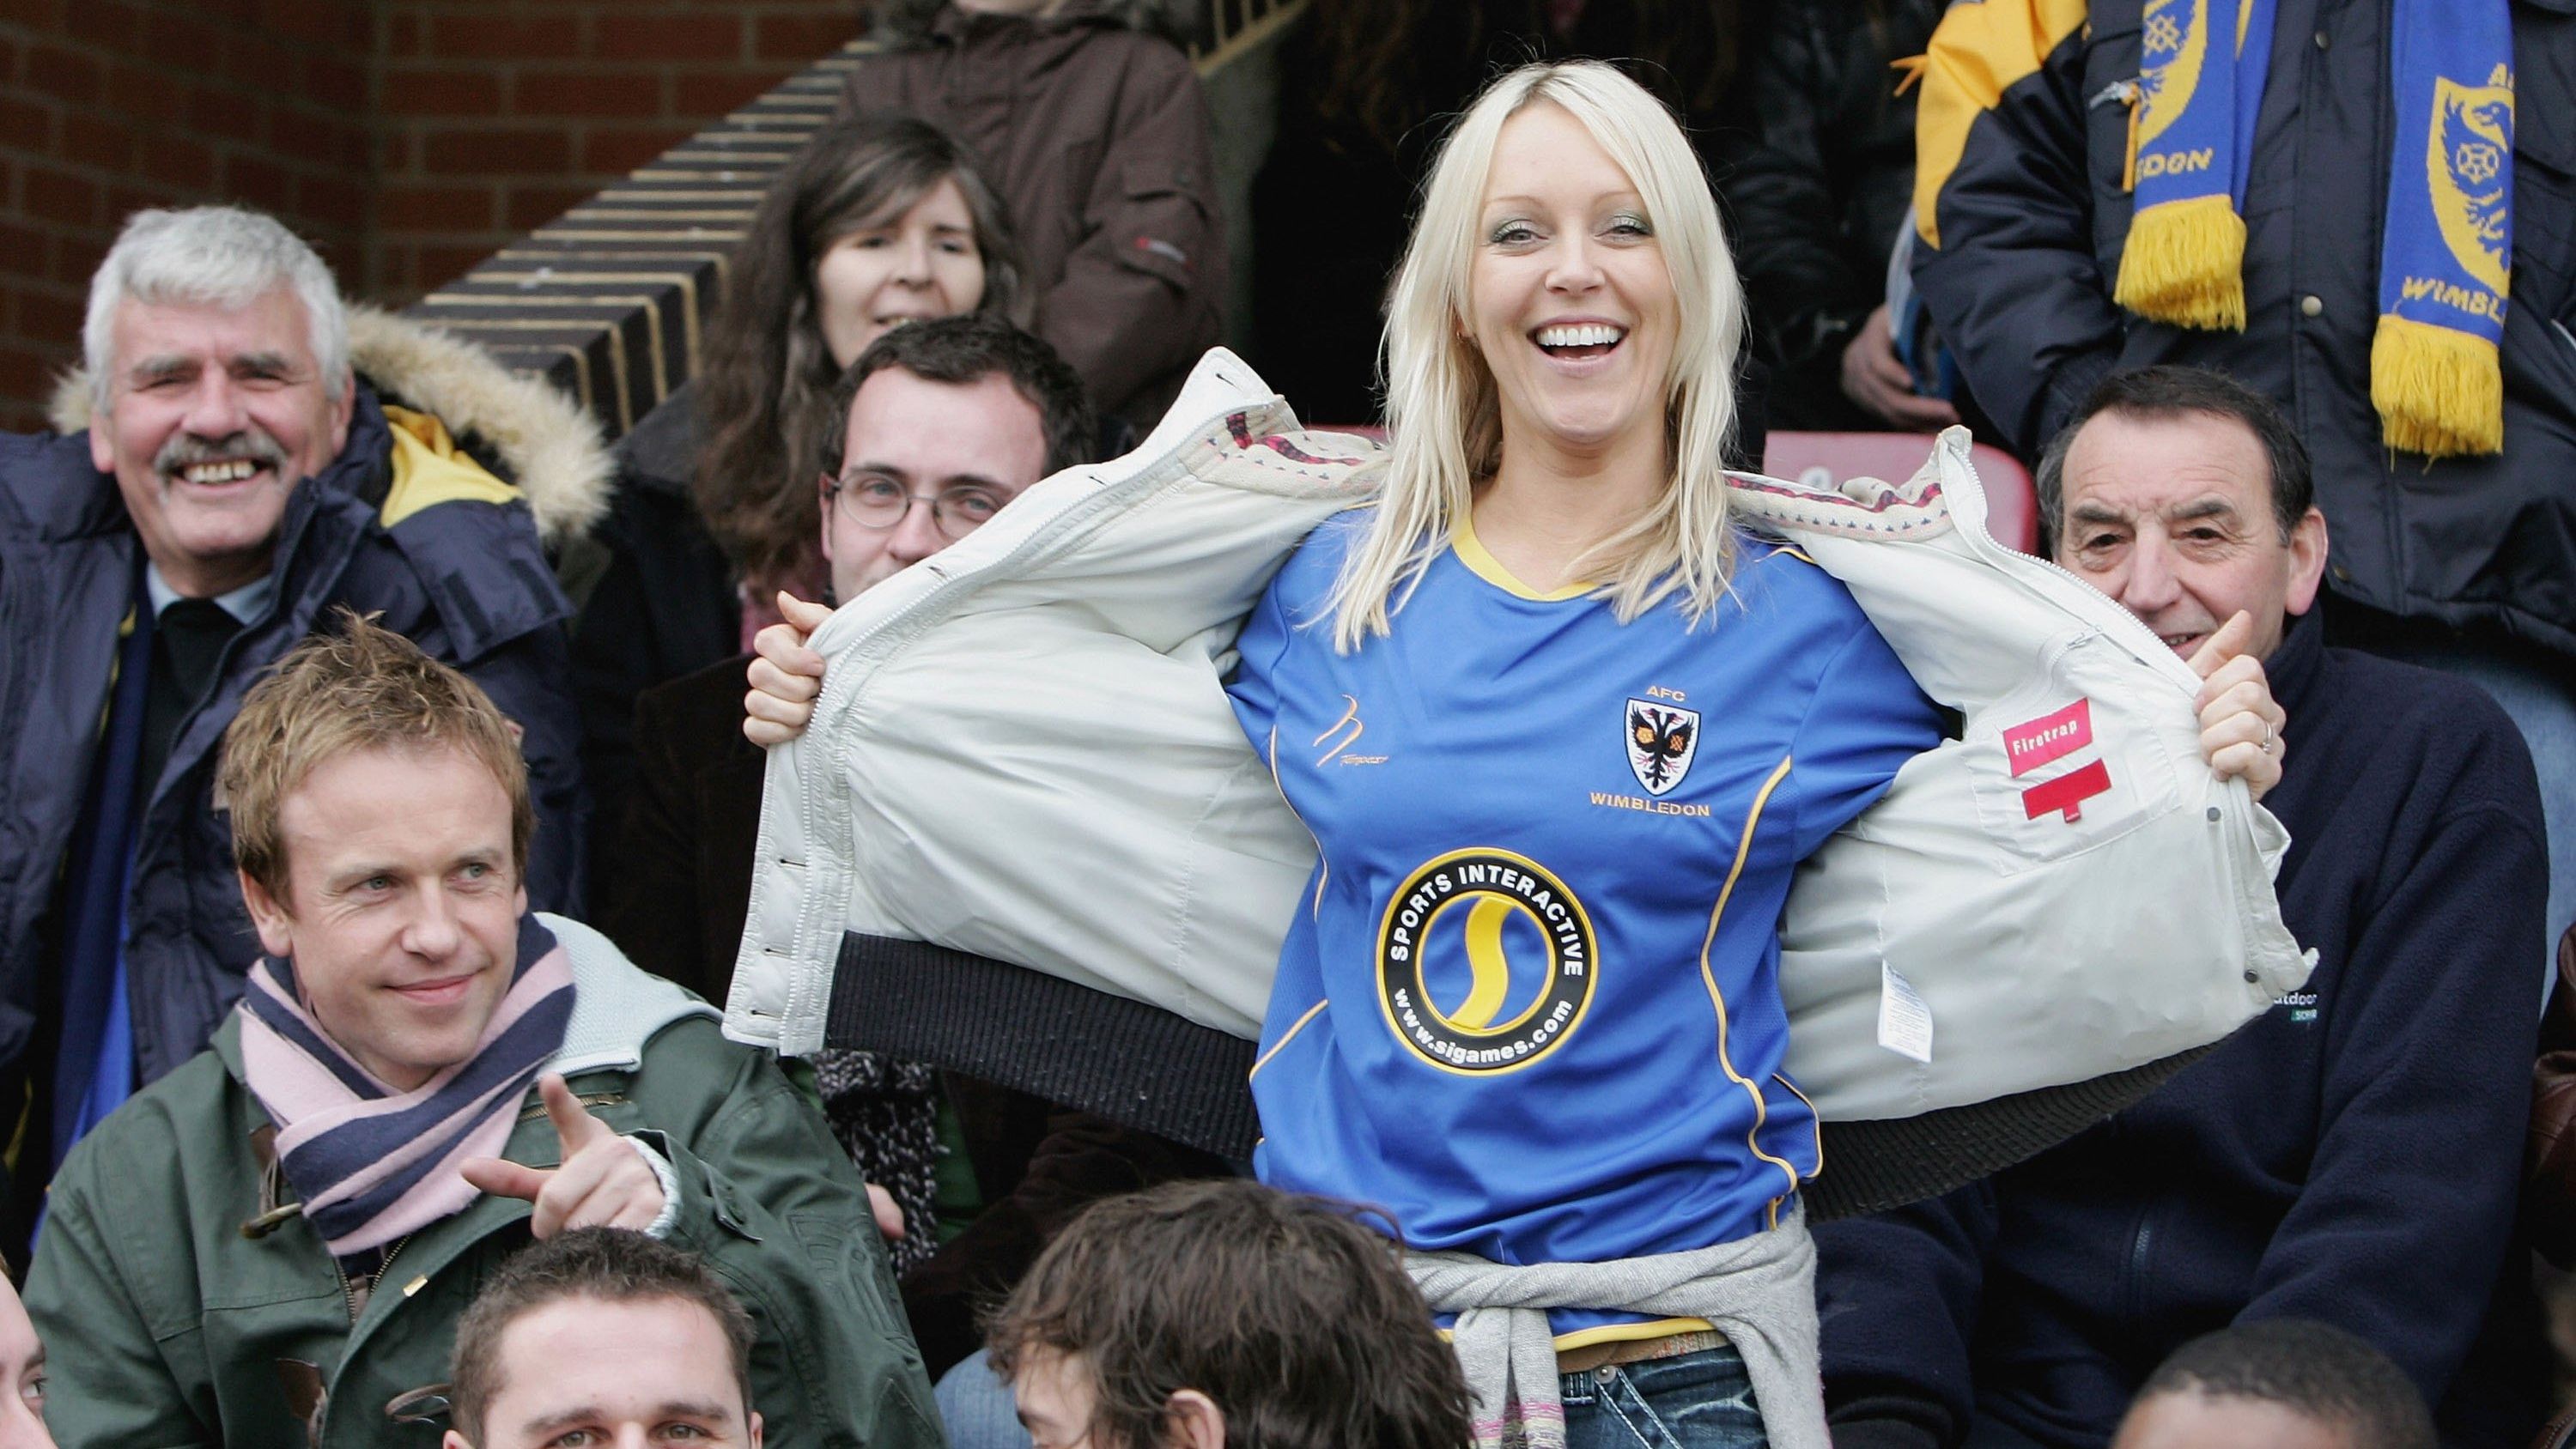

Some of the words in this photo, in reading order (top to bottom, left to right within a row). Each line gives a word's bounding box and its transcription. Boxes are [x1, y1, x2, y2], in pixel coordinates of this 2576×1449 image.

[1646, 685, 1686, 702] AFC
[2012, 719, 2078, 756] Firetrap
[1589, 791, 1710, 816] WIMBLEDON
[1390, 873, 1453, 961] SPORTS
[1458, 864, 1583, 976] INTERACTIVE
[1394, 988, 1572, 1064] www.sigames.com
